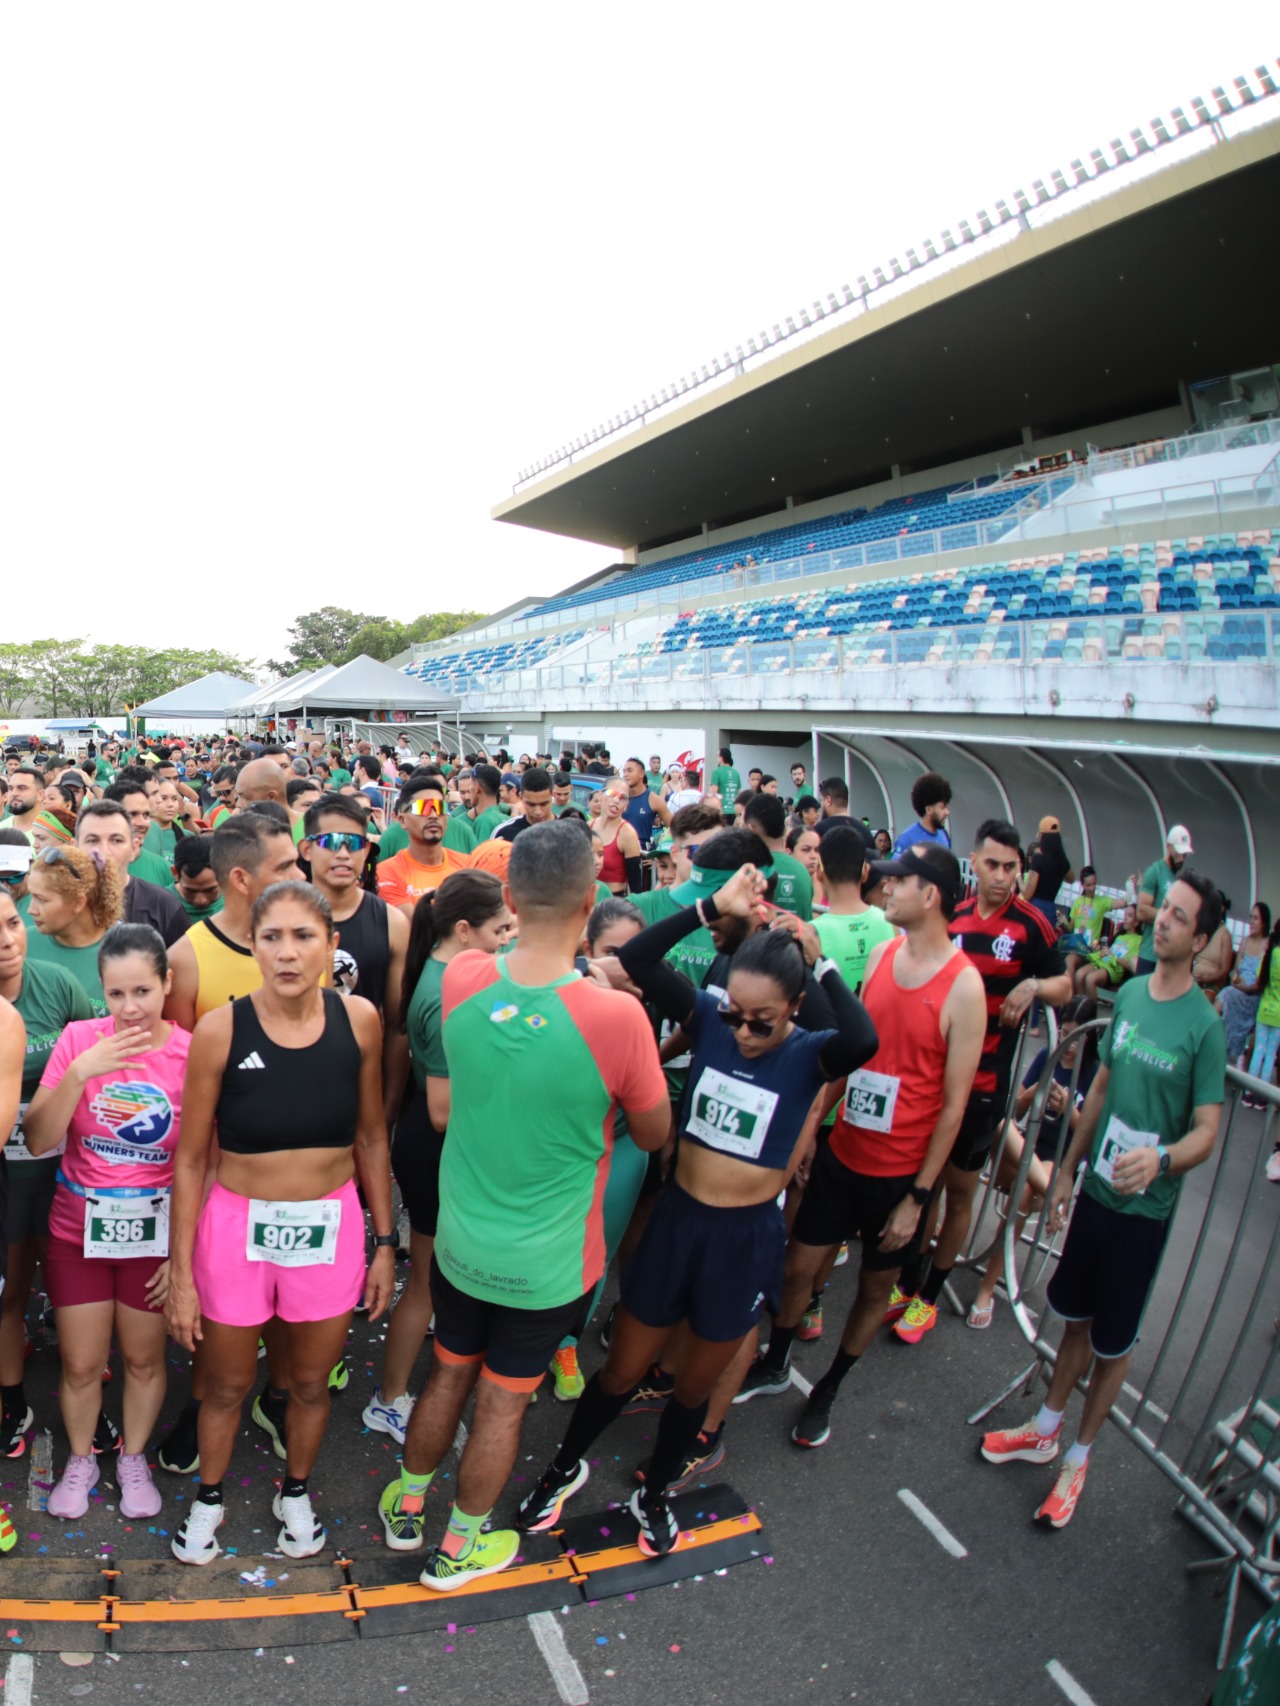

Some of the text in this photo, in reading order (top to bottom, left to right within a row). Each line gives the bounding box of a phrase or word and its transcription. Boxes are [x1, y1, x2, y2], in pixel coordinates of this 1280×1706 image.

[851, 1090, 877, 1115] 954
[705, 1100, 740, 1135] 914
[83, 1138, 136, 1158] RUNNERS
[137, 1151, 169, 1162] TEAM
[100, 1219, 144, 1243] 396
[263, 1225, 312, 1251] 902
